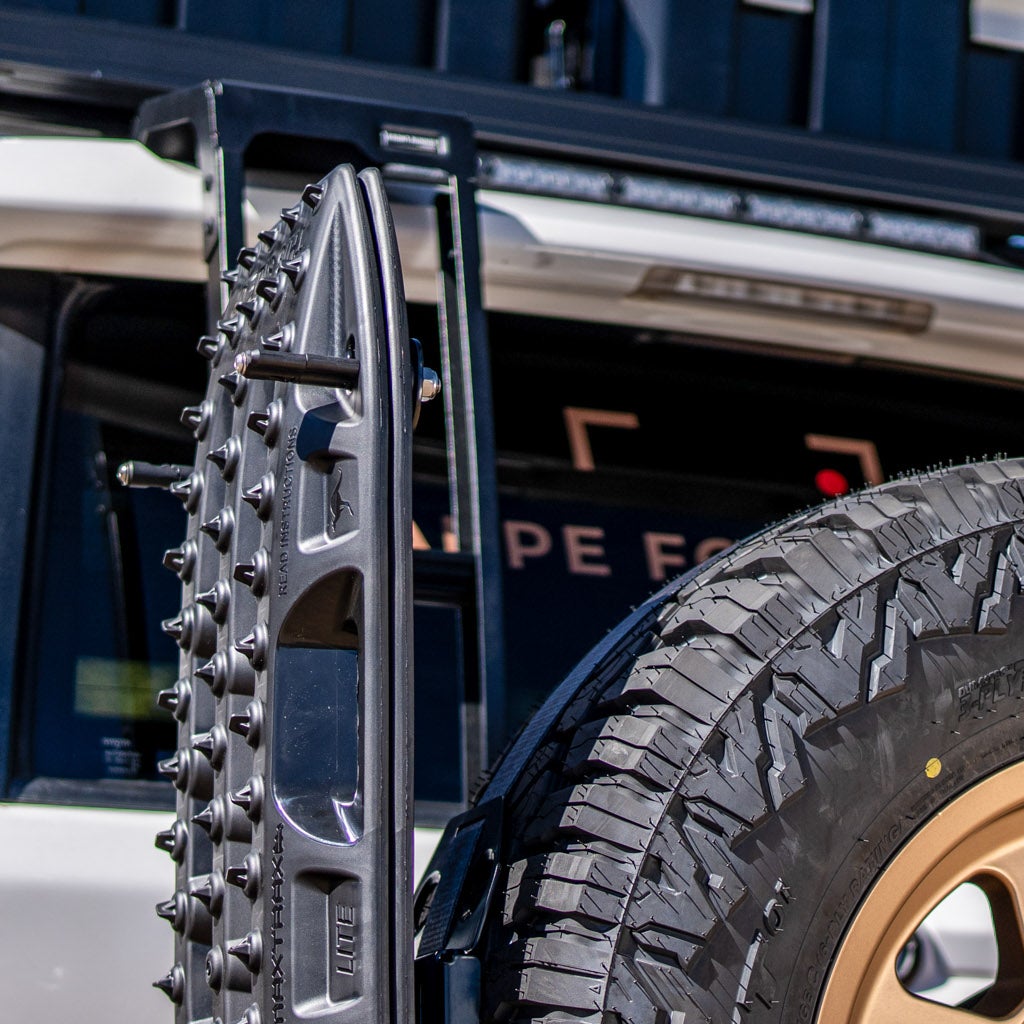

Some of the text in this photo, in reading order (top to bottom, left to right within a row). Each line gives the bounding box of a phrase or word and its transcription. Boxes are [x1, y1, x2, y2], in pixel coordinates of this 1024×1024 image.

[278, 426, 298, 597] READ INSTRUCTIONS
[335, 903, 355, 976] LITE
